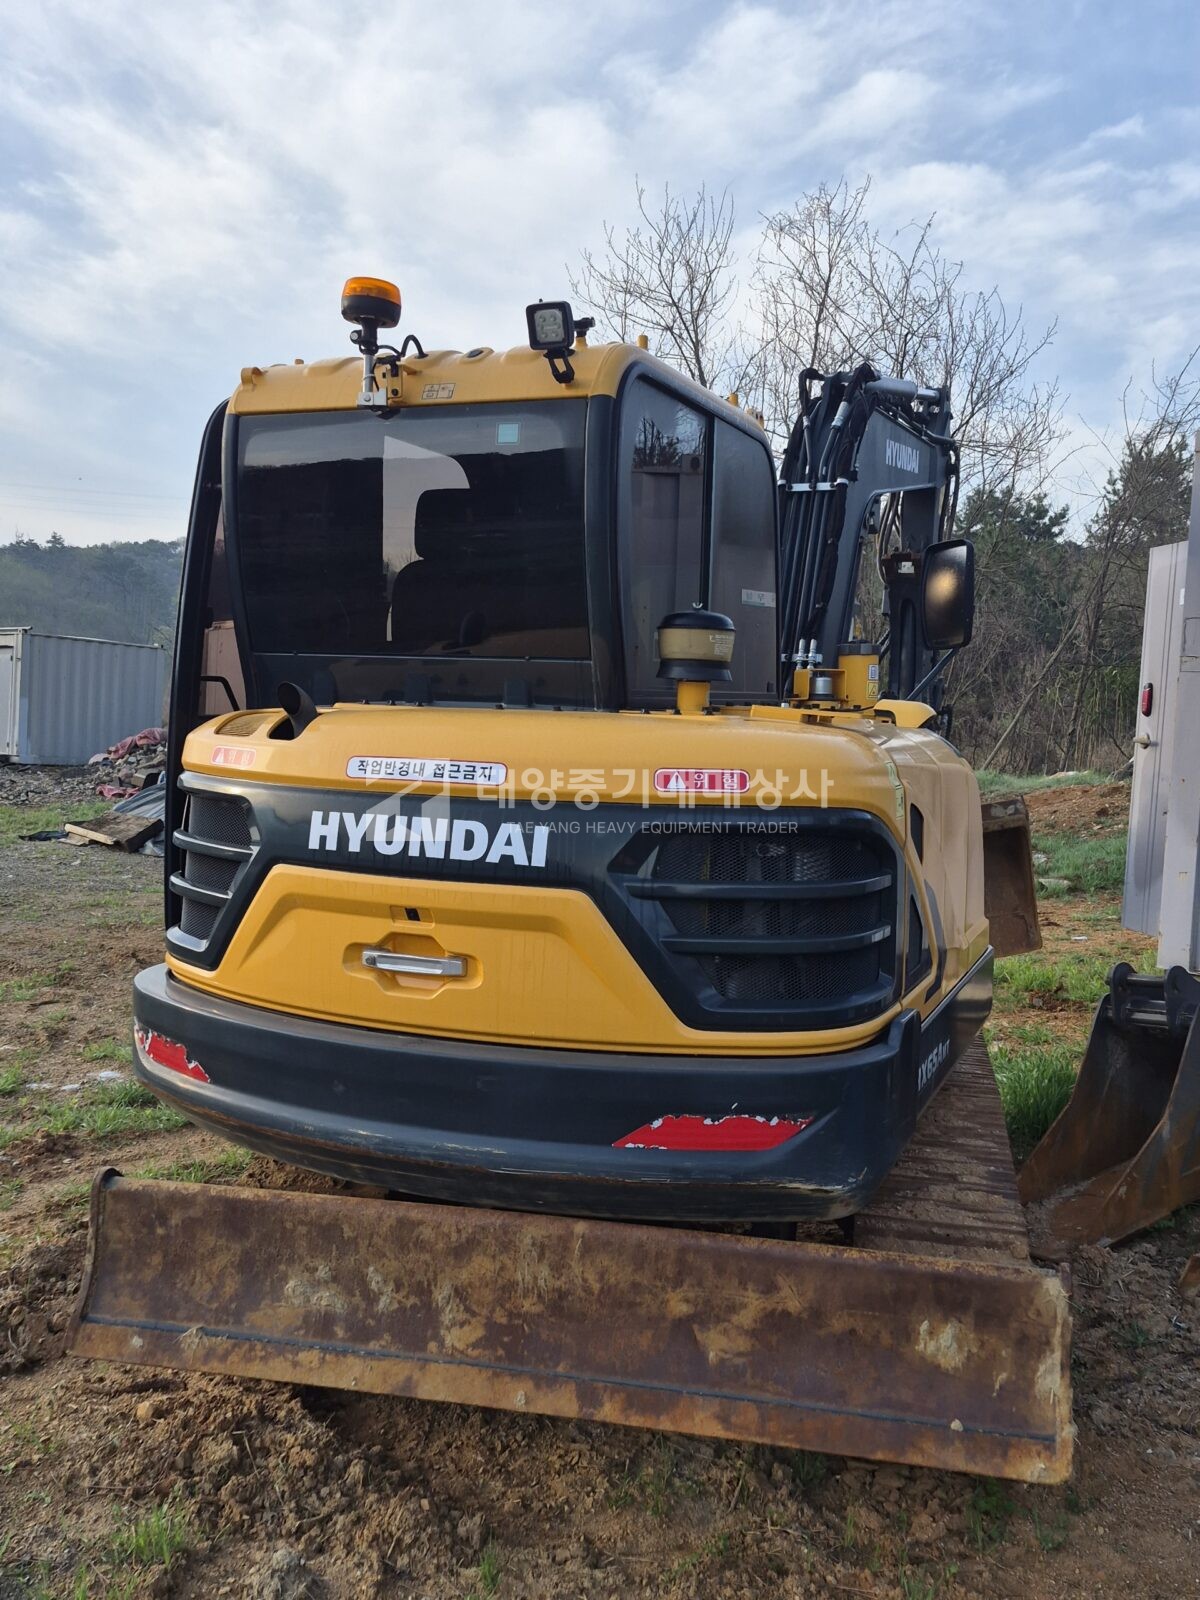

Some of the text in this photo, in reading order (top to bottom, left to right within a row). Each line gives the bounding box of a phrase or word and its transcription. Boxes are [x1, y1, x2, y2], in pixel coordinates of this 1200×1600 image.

[885, 439, 920, 474] HYUNDAI
[357, 759, 493, 782] 작업반경내 접근금지
[308, 810, 549, 868] HYUNDAI
